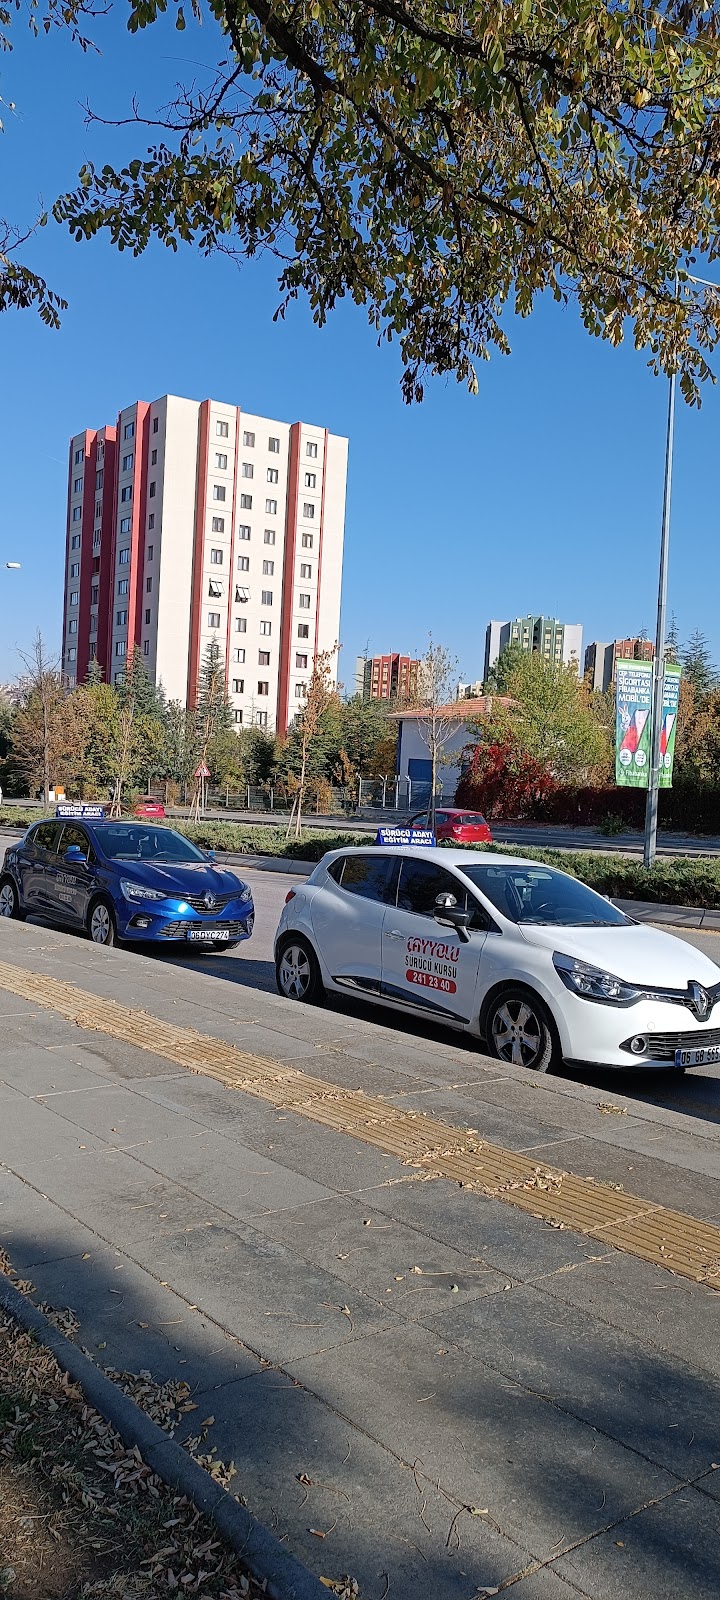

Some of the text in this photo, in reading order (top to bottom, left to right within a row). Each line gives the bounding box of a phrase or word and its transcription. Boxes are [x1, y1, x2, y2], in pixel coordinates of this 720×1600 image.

[381, 829, 410, 837] SÜRÜCÜ
[383, 836, 409, 844] EĞİTİM
[405, 953, 458, 979] SÜRÜCÜ KURSU
[413, 972, 450, 991] 241 23 40
[682, 1051, 691, 1065] 06
